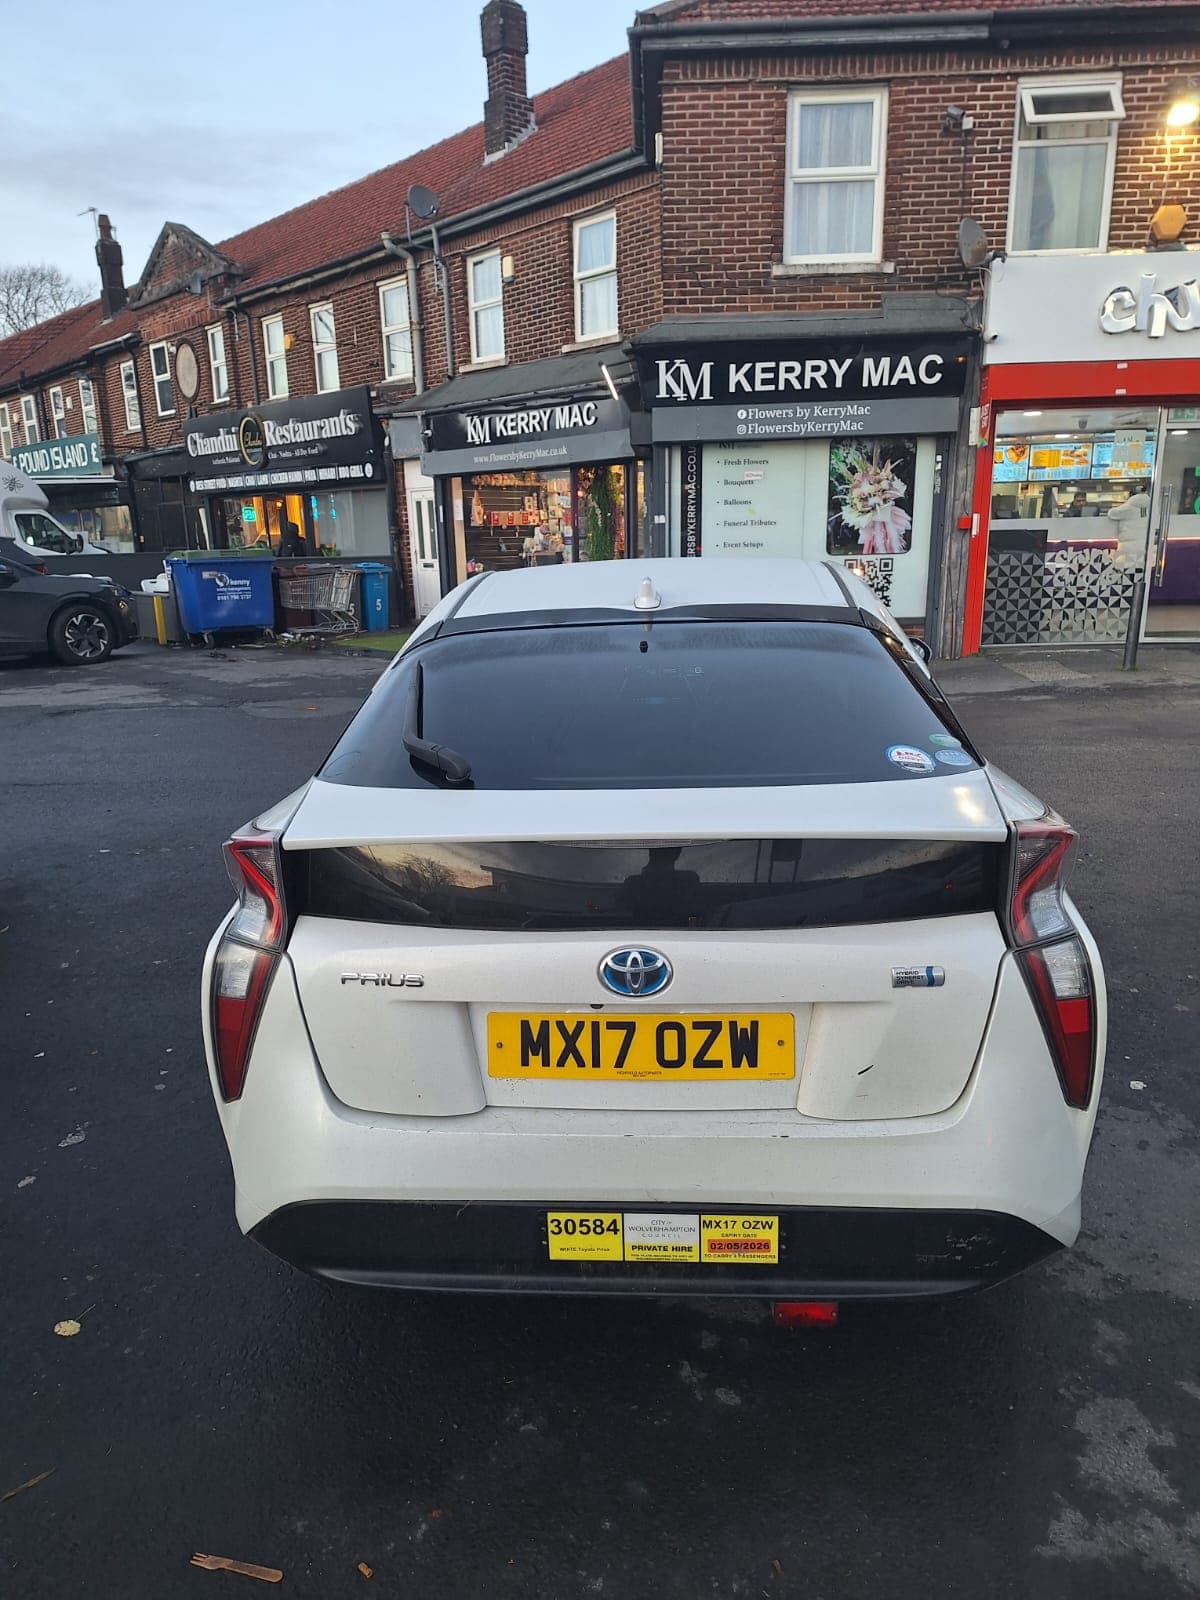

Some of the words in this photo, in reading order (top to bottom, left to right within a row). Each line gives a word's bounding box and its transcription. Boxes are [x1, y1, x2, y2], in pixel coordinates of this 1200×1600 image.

[655, 359, 714, 401] KM
[728, 357, 853, 393] KERRY
[862, 353, 944, 388] MAC
[748, 407, 794, 420] Flowers
[796, 406, 810, 421] by
[813, 404, 871, 418] KerryMac
[466, 414, 491, 445] KM
[495, 408, 552, 437] KERRY
[555, 401, 598, 430] MAC
[748, 419, 865, 436] FlowersbyKerryMac
[187, 426, 240, 458] Chandni
[262, 408, 356, 447] Restaurants
[18, 448, 50, 474] POUND
[49, 442, 88, 470] ISLAND
[91, 441, 99, 463] £
[473, 446, 568, 464] www.FlowersbyKerryMac.co.uk
[723, 458, 742, 466] Fresh
[743, 458, 769, 466] Flowers
[723, 479, 754, 488] Bouquets
[742, 541, 764, 549] Setups
[230, 578, 250, 587] kenny
[376, 599, 382, 611] 5
[341, 972, 425, 988] PRIUS
[520, 1019, 637, 1069] MX17
[655, 1020, 759, 1069] OZW
[549, 1218, 620, 1236] 30584
[628, 1225, 696, 1233] WOLVERHAMPTON
[702, 1220, 737, 1230] MX17
[741, 1220, 774, 1231] OZW
[631, 1244, 669, 1252] PRIVATE
[671, 1245, 693, 1253] HIRE
[709, 1242, 770, 1251] 02/05/2026
